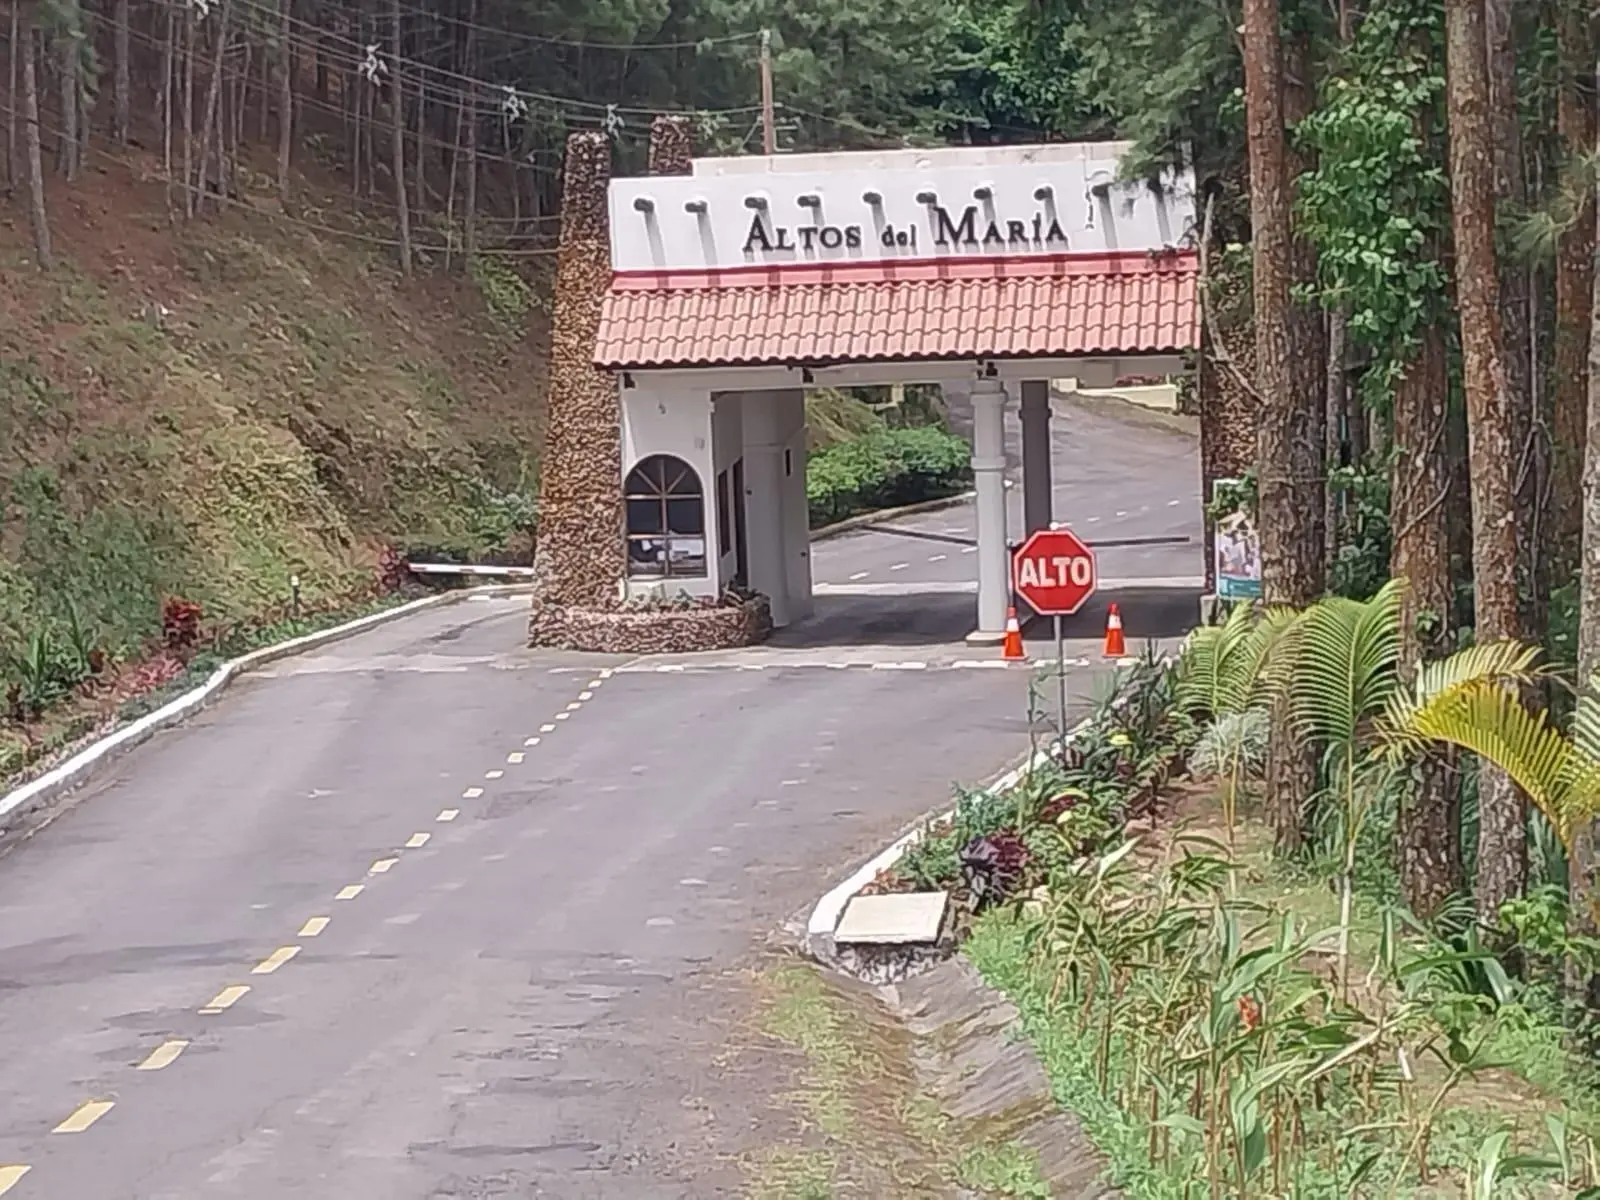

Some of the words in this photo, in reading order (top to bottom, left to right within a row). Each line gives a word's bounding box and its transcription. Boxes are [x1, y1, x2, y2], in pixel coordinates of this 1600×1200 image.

[743, 214, 861, 251] ALTOS
[881, 223, 917, 247] del
[1020, 557, 1091, 587] ALTO
